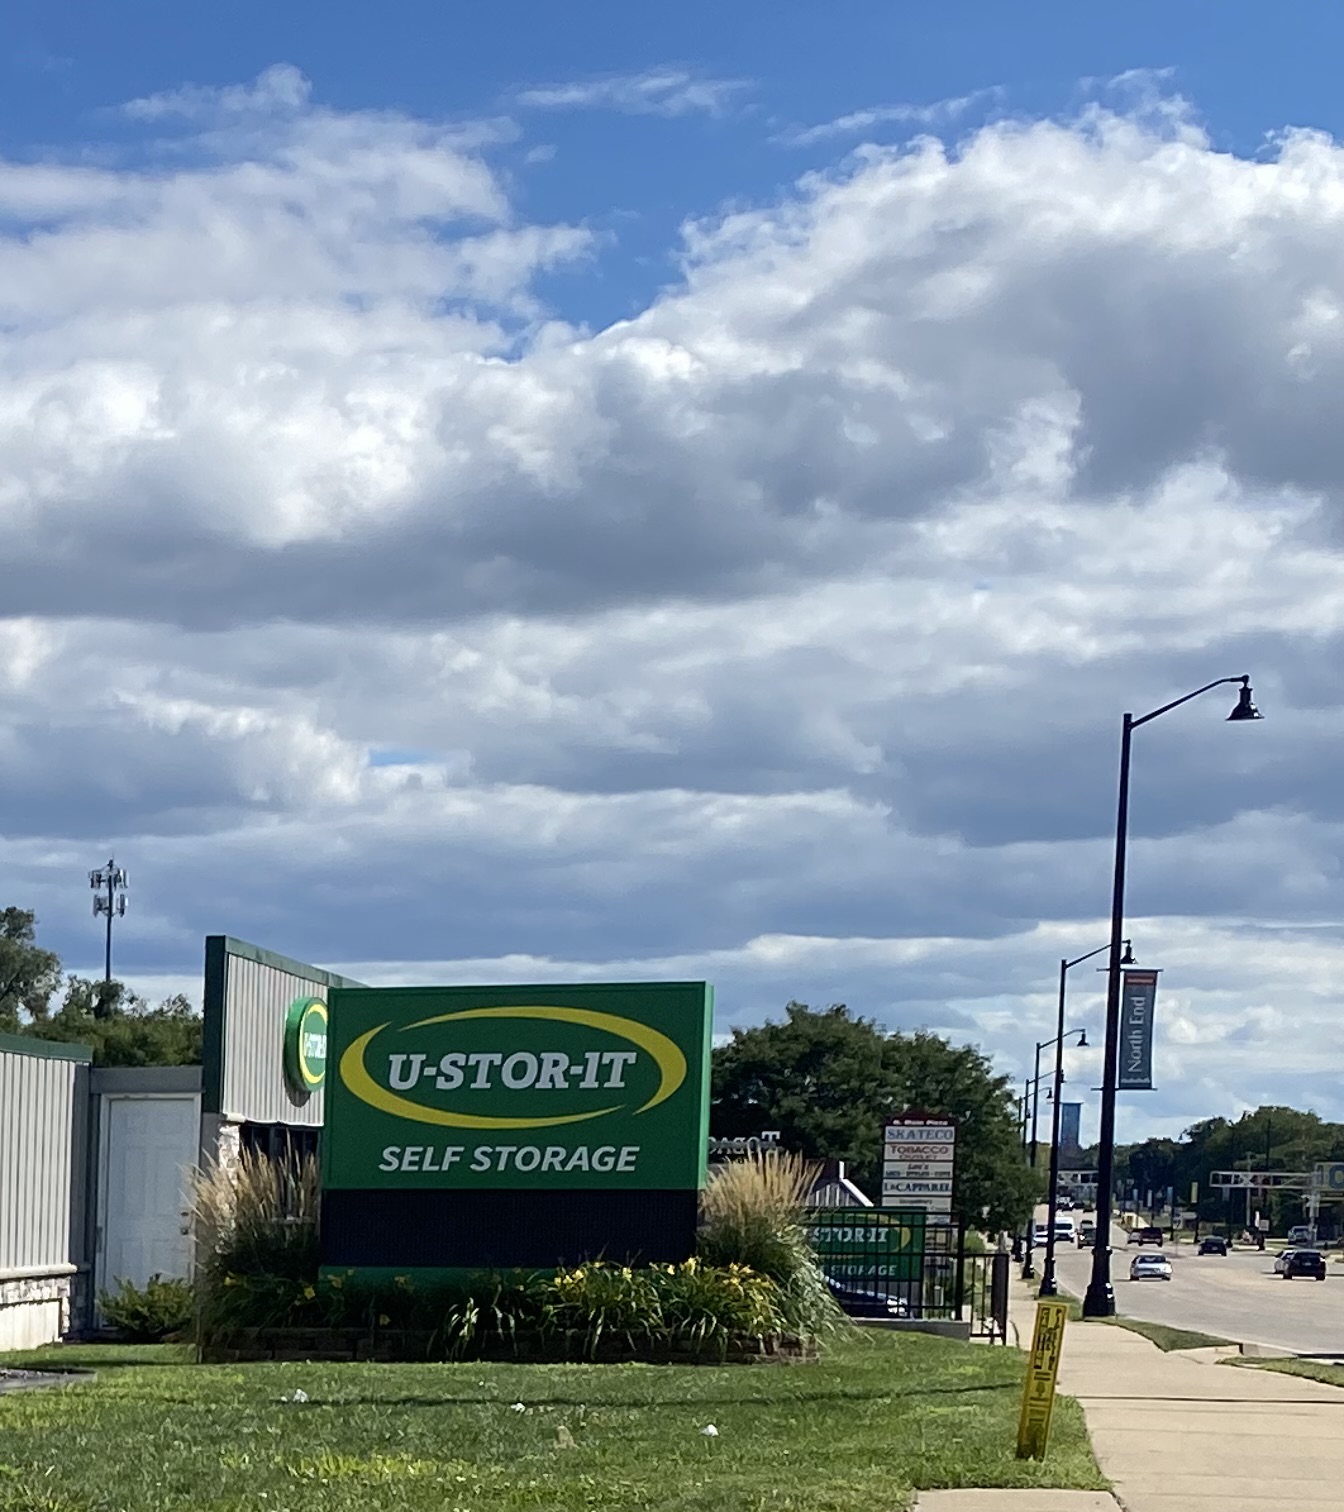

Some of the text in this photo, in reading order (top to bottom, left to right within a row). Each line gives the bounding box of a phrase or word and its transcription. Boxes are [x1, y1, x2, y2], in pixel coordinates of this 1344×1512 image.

[1129, 996, 1147, 1025] End
[1127, 1030, 1143, 1073] North
[388, 1051, 638, 1091] U-STOR-IT
[378, 1145, 641, 1172] SELF STORAGE
[891, 1145, 948, 1154] TOBACCO
[812, 1226, 890, 1243] STOR-IT
